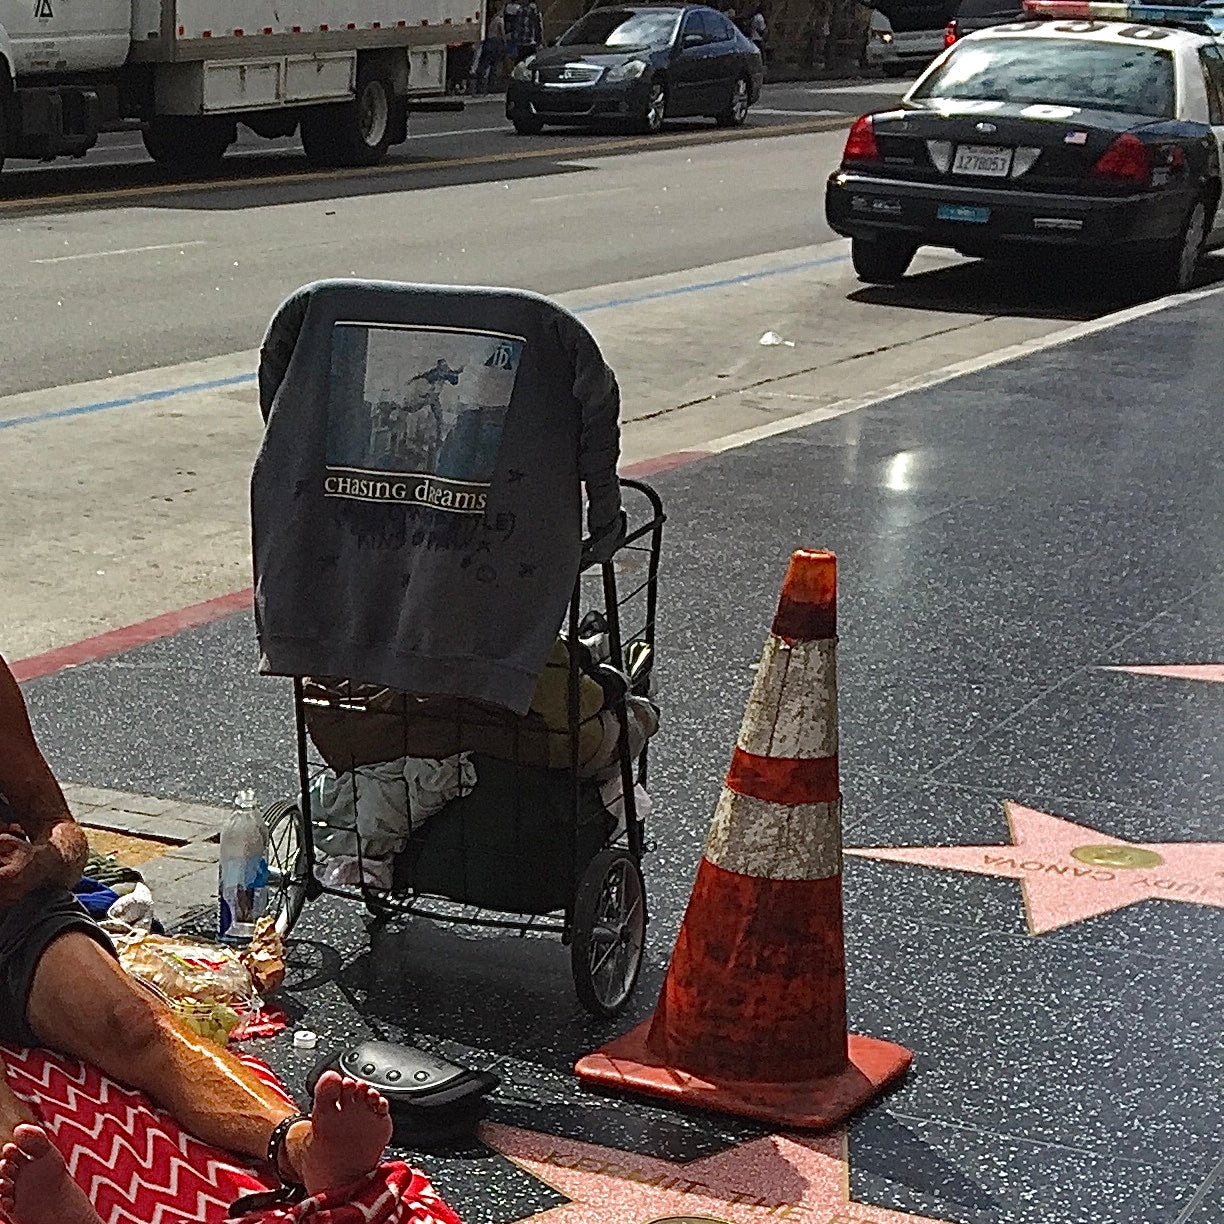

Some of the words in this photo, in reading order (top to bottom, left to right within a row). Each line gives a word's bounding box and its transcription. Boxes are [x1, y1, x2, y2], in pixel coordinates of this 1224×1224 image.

[984, 854, 1116, 881] CANOVA
[1130, 878, 1208, 896] JUDY
[547, 1150, 709, 1195] KERMIT
[727, 1189, 813, 1222] THE
